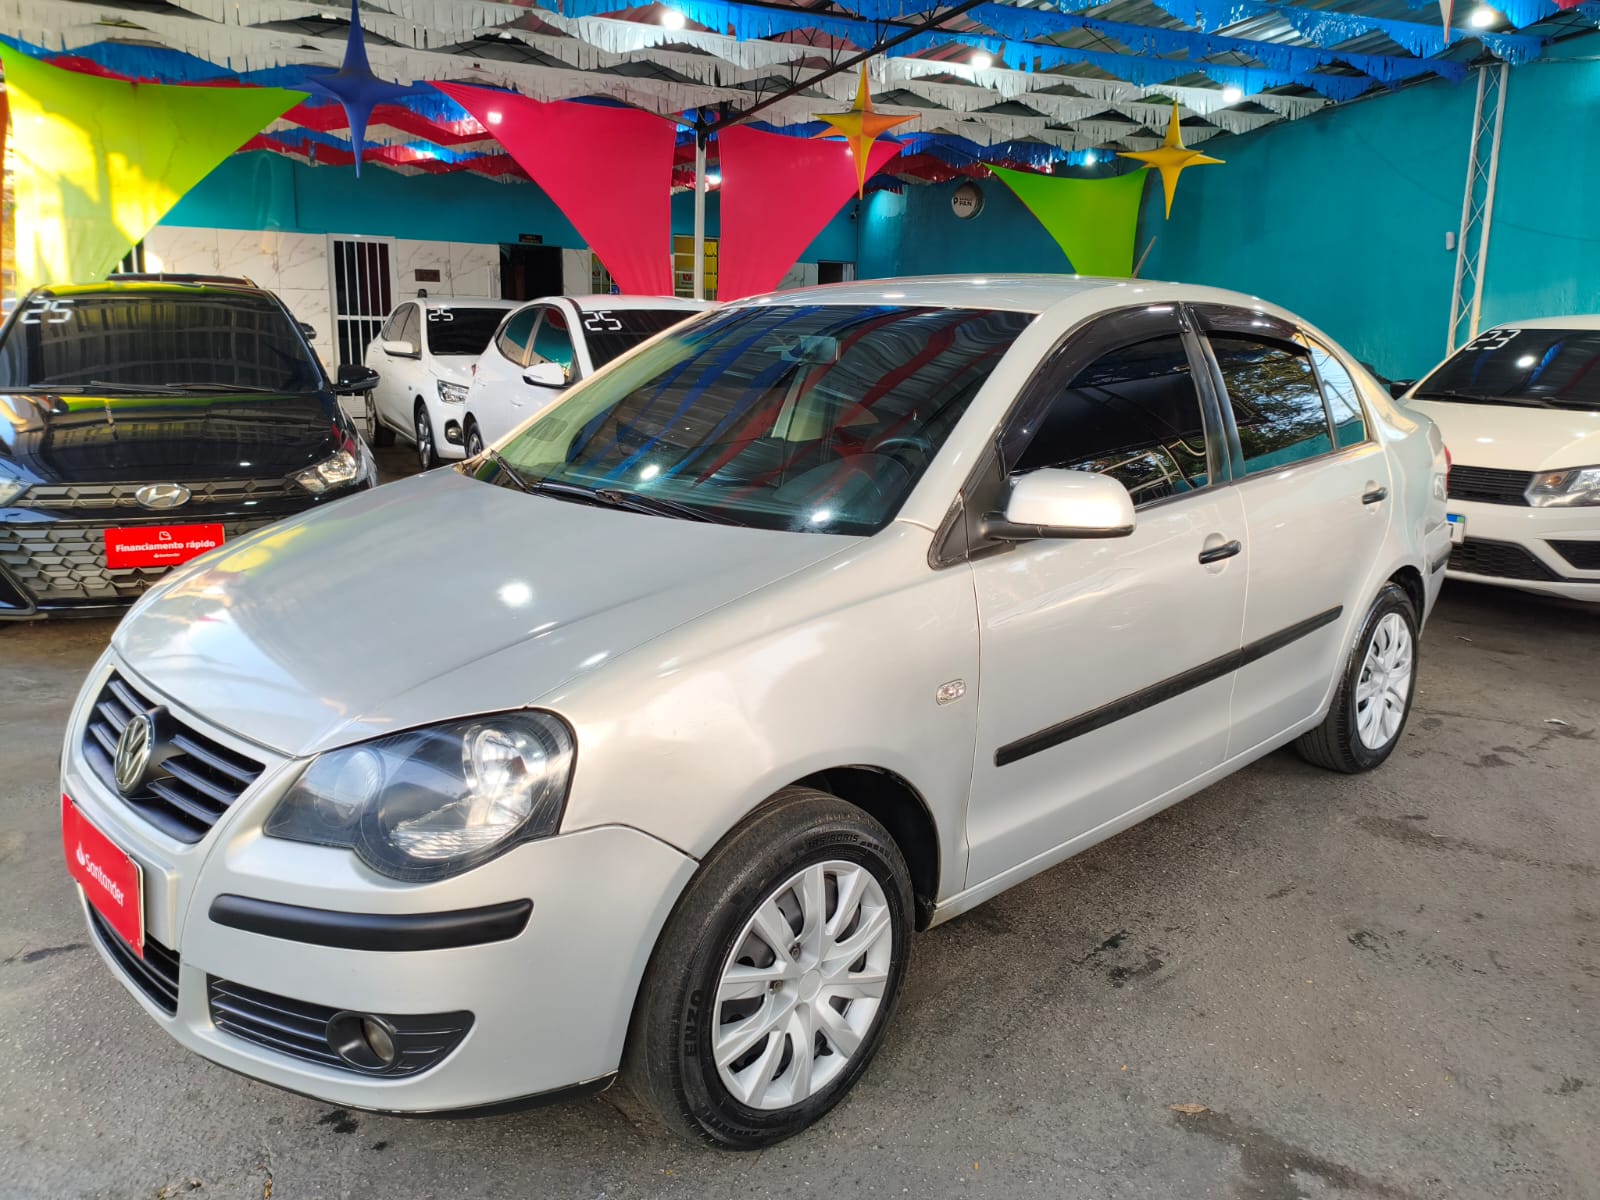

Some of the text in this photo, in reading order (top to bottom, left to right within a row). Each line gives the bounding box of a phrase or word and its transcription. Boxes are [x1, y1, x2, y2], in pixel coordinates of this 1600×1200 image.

[21, 299, 75, 324] 25
[428, 308, 454, 321] 25
[582, 311, 622, 331] 25
[1465, 329, 1521, 350] 23
[115, 539, 216, 553] Financiamento rápido
[85, 853, 125, 908] Santander
